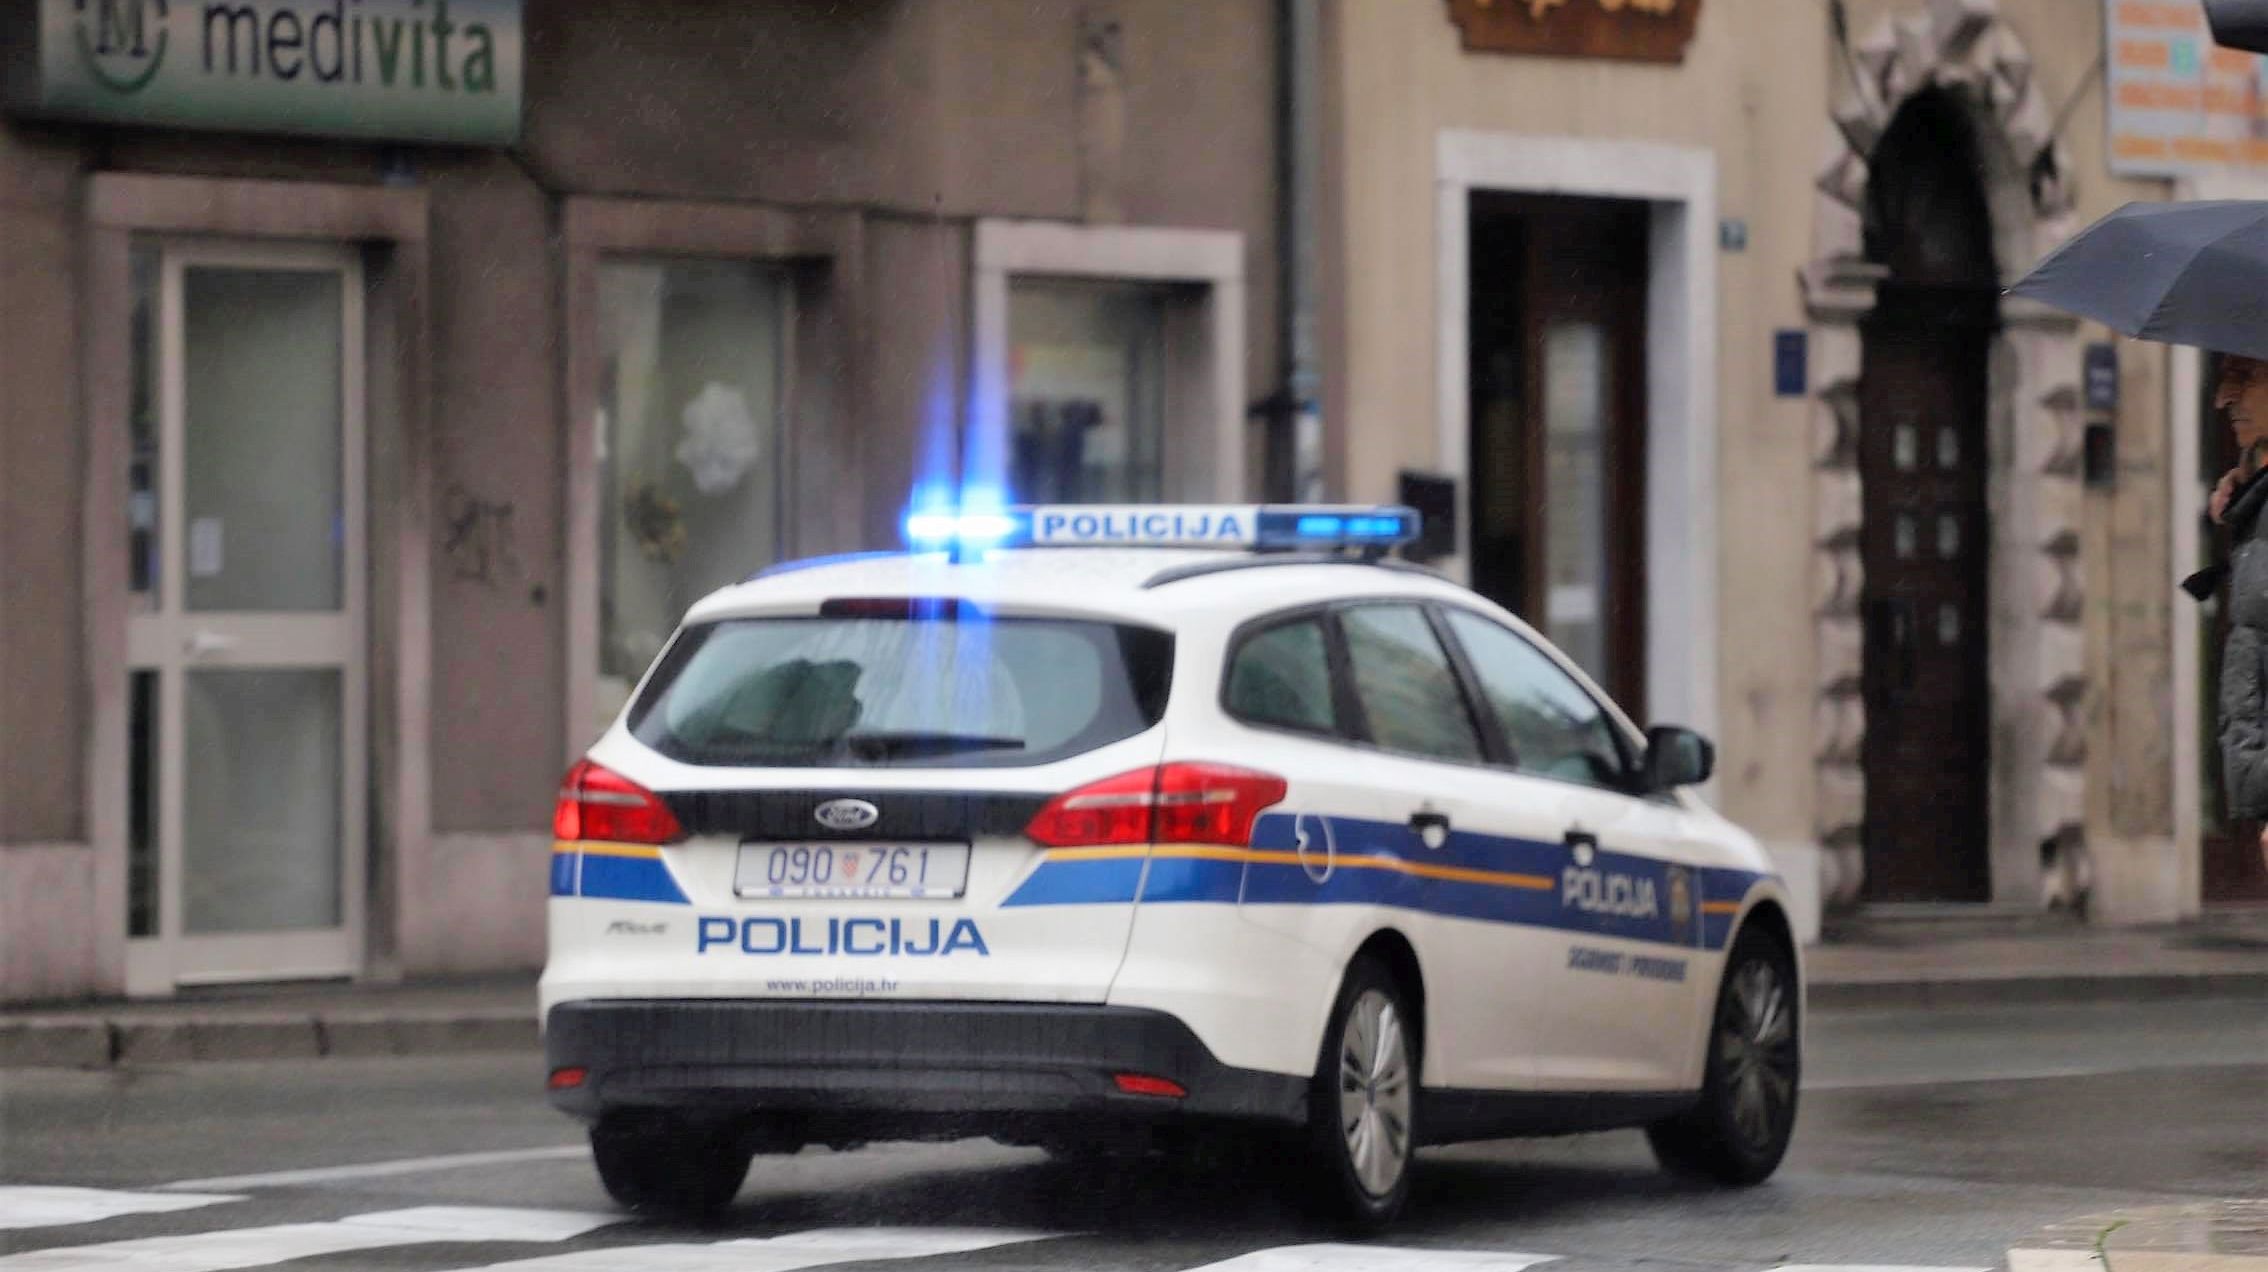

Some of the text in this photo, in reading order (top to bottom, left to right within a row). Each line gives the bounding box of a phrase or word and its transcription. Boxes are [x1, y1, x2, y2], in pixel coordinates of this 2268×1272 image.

[202, 0, 497, 93] medivita
[1043, 513, 1243, 540] POLICIJA
[768, 846, 930, 885] 090 761
[1562, 865, 1658, 919] POLICIJA
[697, 916, 991, 957] POLICIJA
[767, 976, 897, 996] www.policija.hr
